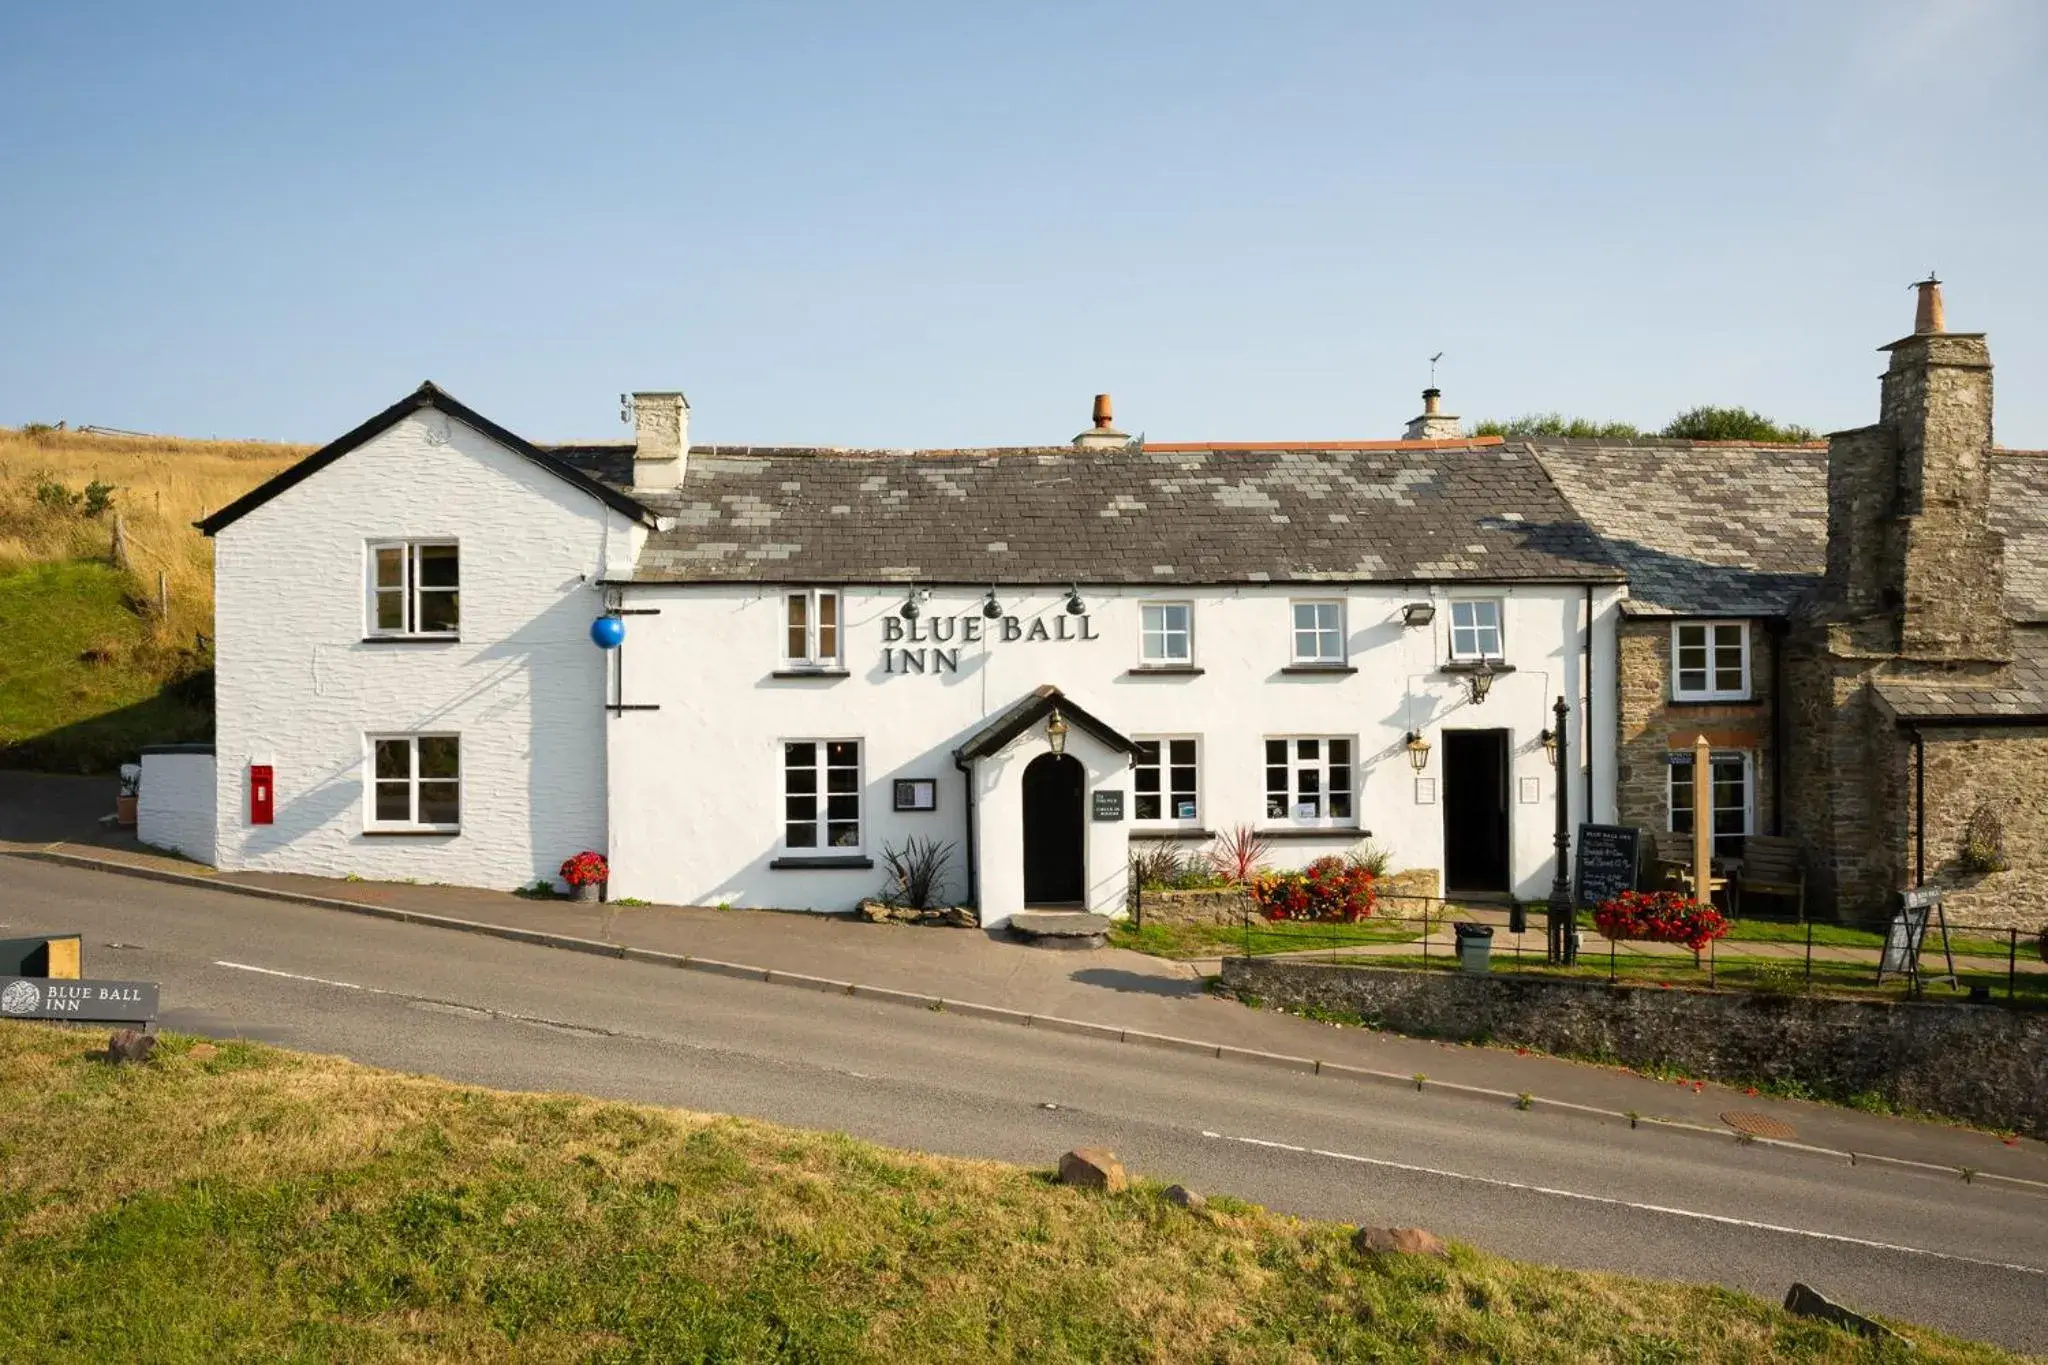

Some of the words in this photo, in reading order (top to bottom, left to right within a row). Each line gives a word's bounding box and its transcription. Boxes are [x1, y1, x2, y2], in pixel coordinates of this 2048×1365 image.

[883, 616, 982, 642] BLUE
[1002, 614, 1100, 642] BALL
[883, 648, 959, 674] INN
[48, 986, 92, 999] BLUE
[99, 988, 142, 1001] BALL
[46, 999, 80, 1011] INN
